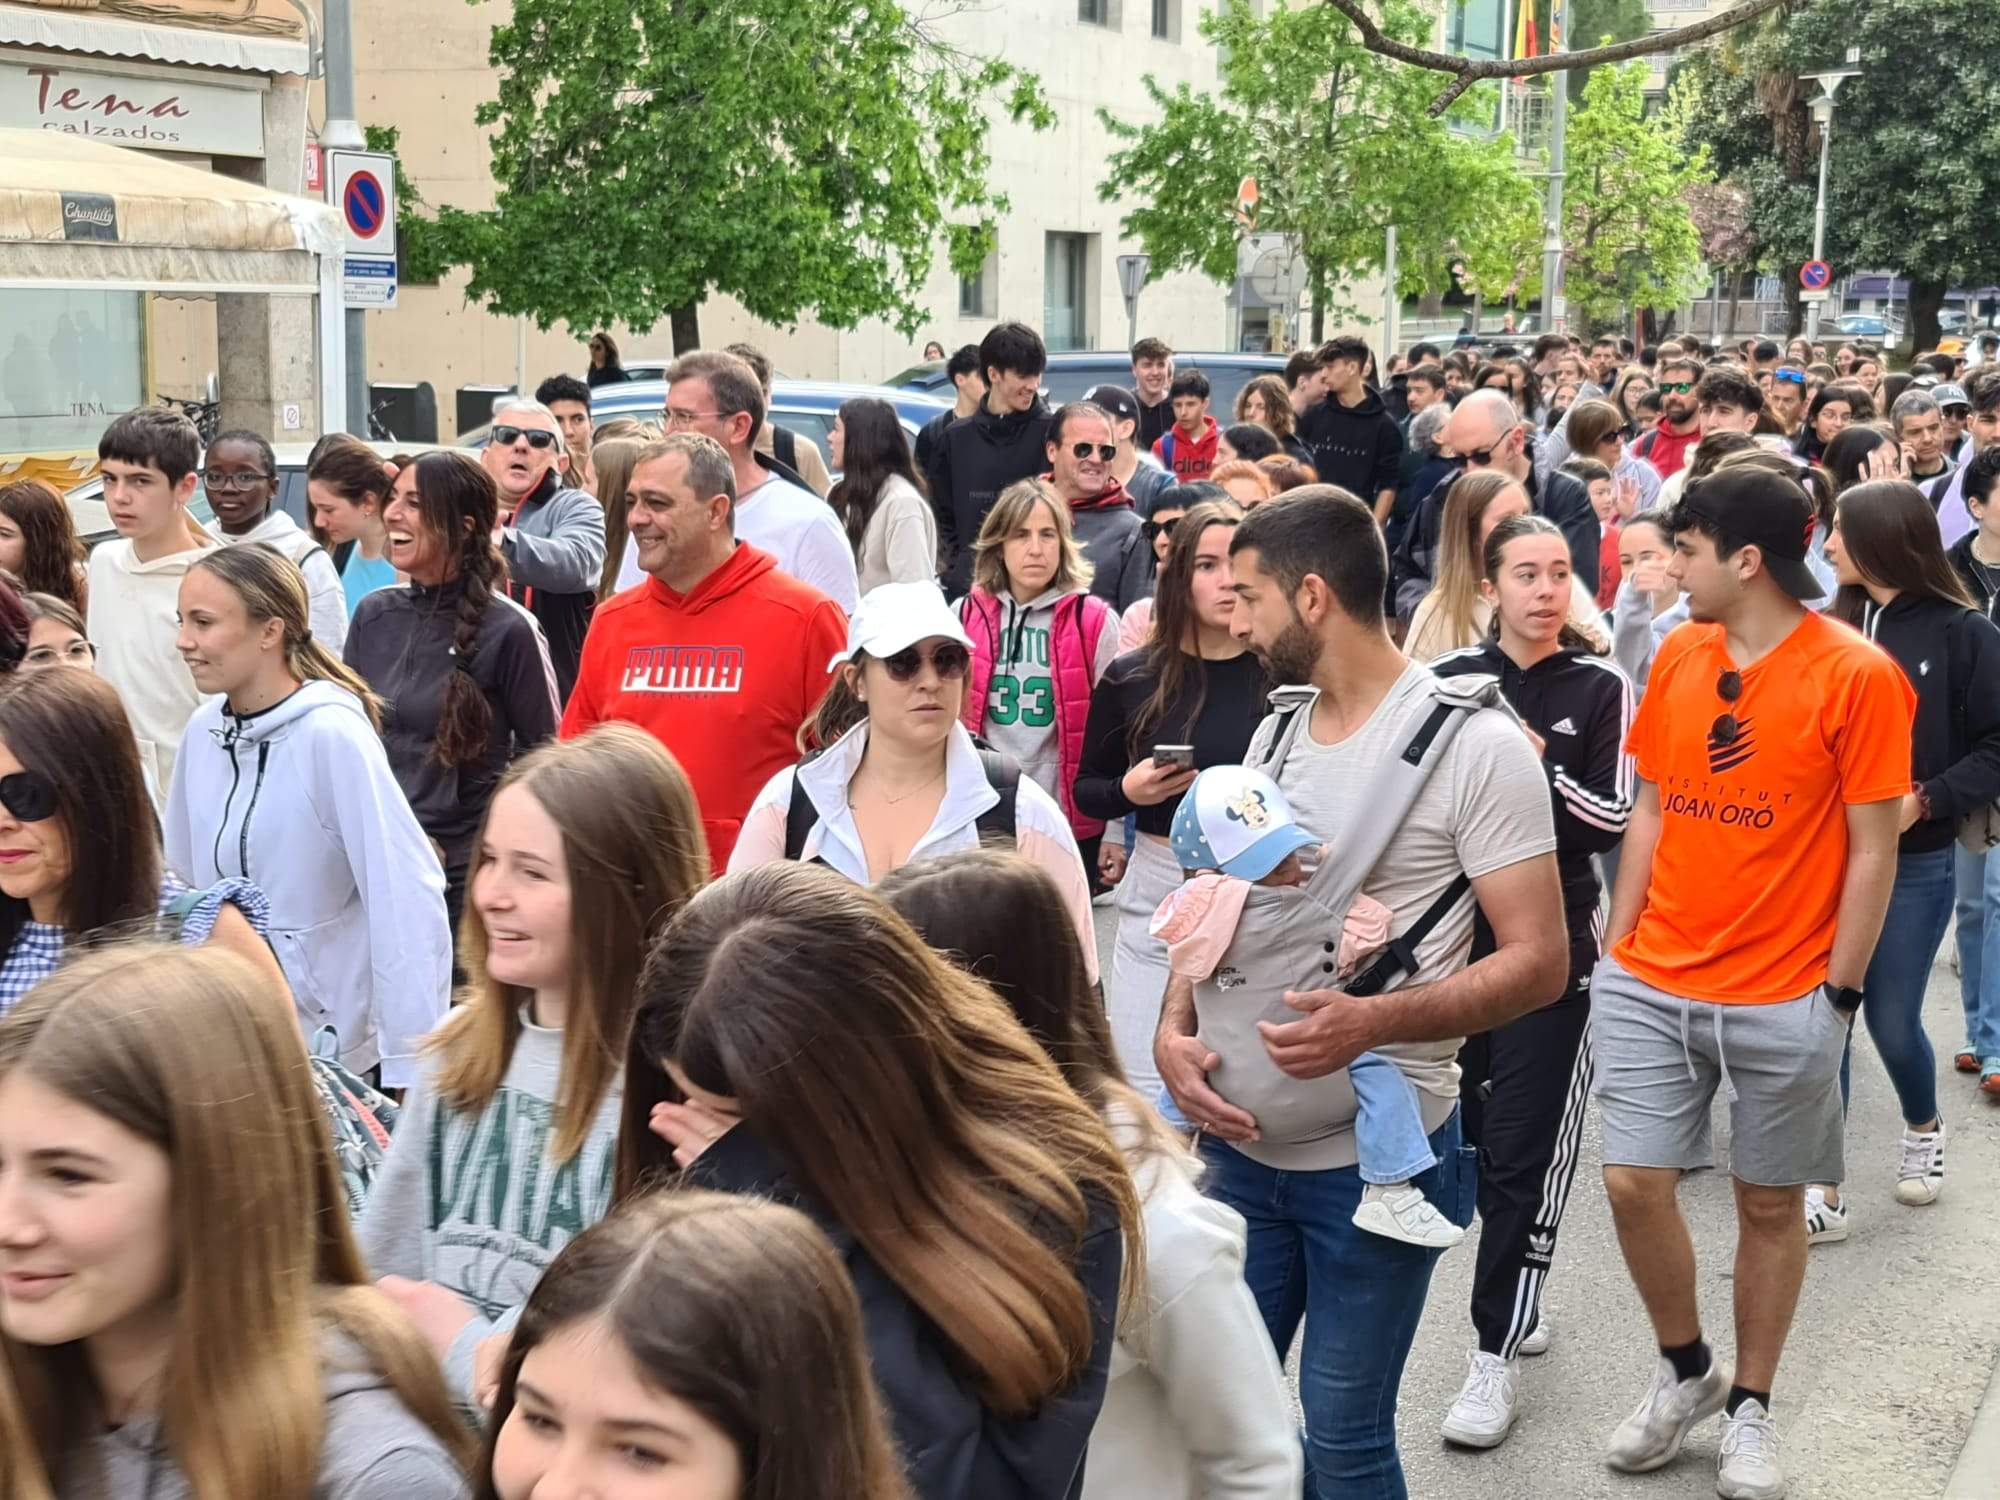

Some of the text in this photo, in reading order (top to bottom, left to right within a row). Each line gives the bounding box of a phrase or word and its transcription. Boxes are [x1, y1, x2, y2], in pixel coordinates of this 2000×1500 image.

[27, 68, 190, 118] Tena
[620, 645, 743, 692] PUMA
[988, 674, 1055, 727] 33
[1663, 793, 1774, 829] JOAN ORÓ
